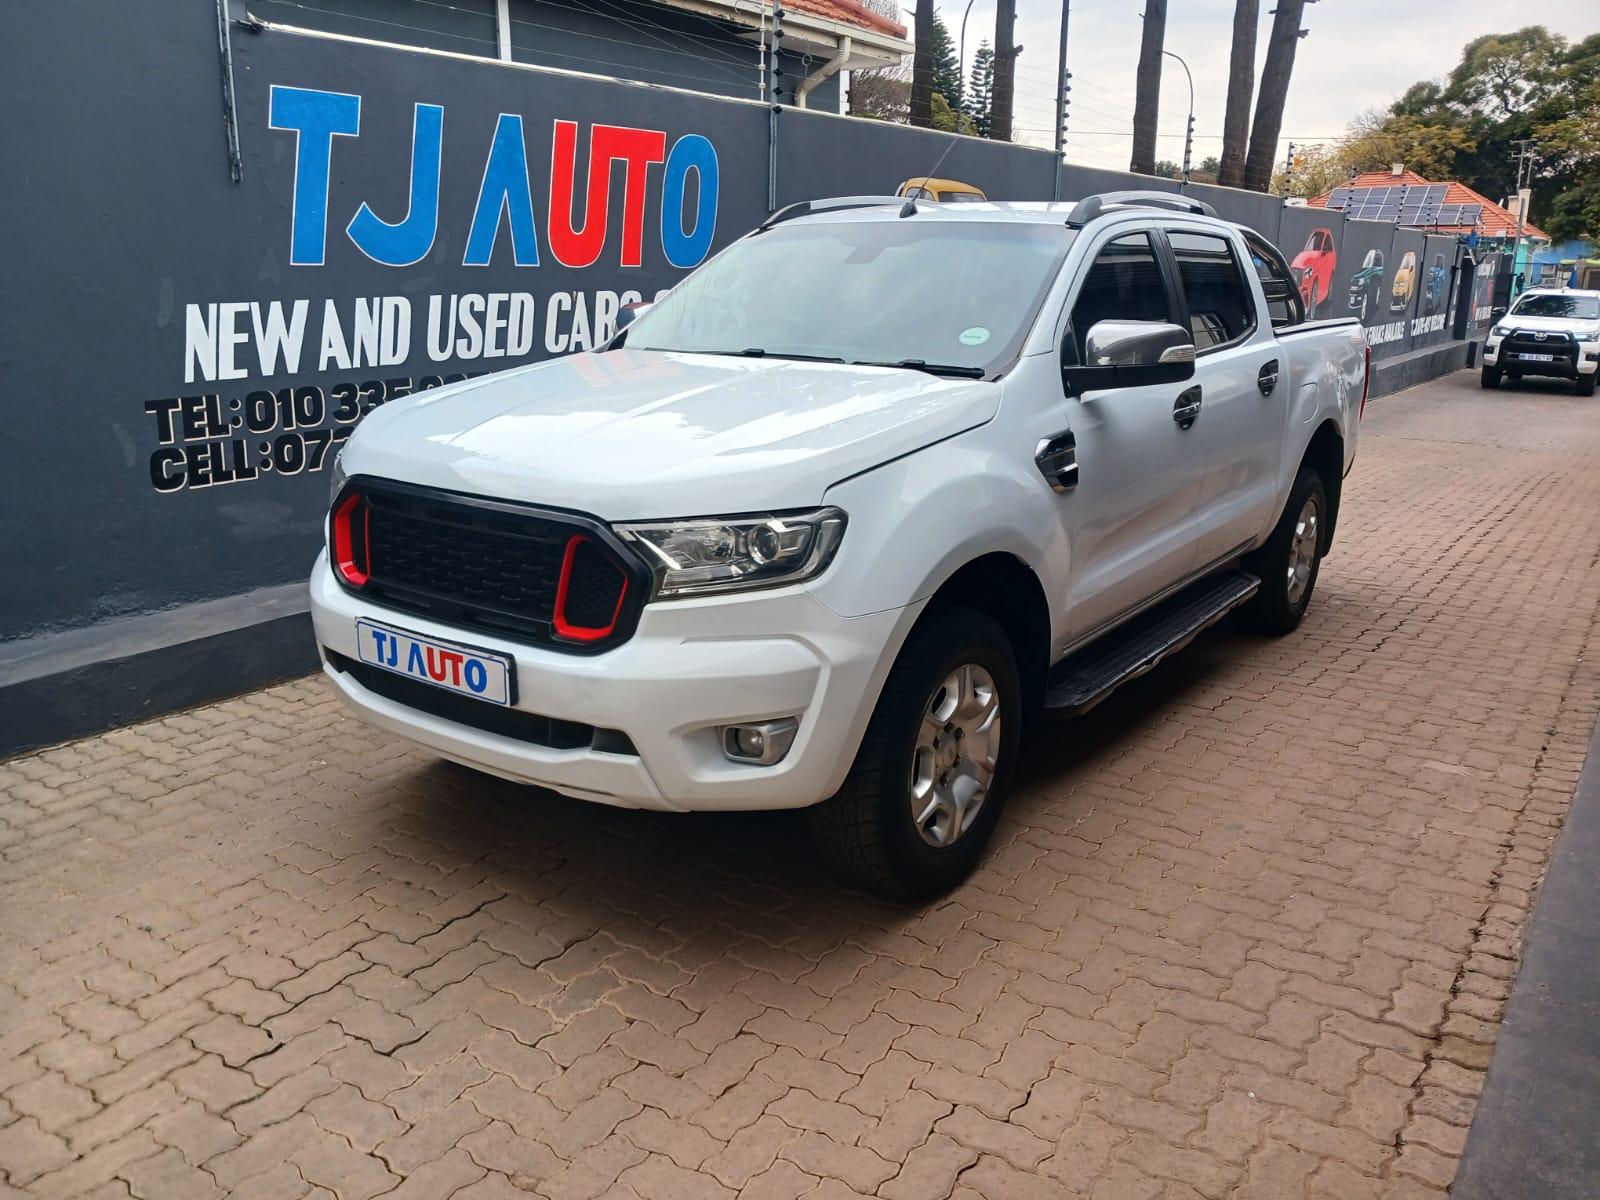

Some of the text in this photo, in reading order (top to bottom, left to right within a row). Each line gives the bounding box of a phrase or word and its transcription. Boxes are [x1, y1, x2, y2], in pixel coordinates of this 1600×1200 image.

[268, 84, 720, 269] TJ AUTO
[184, 289, 644, 384] NEW AND USED CAR
[371, 630, 488, 693] TJ AUTO
